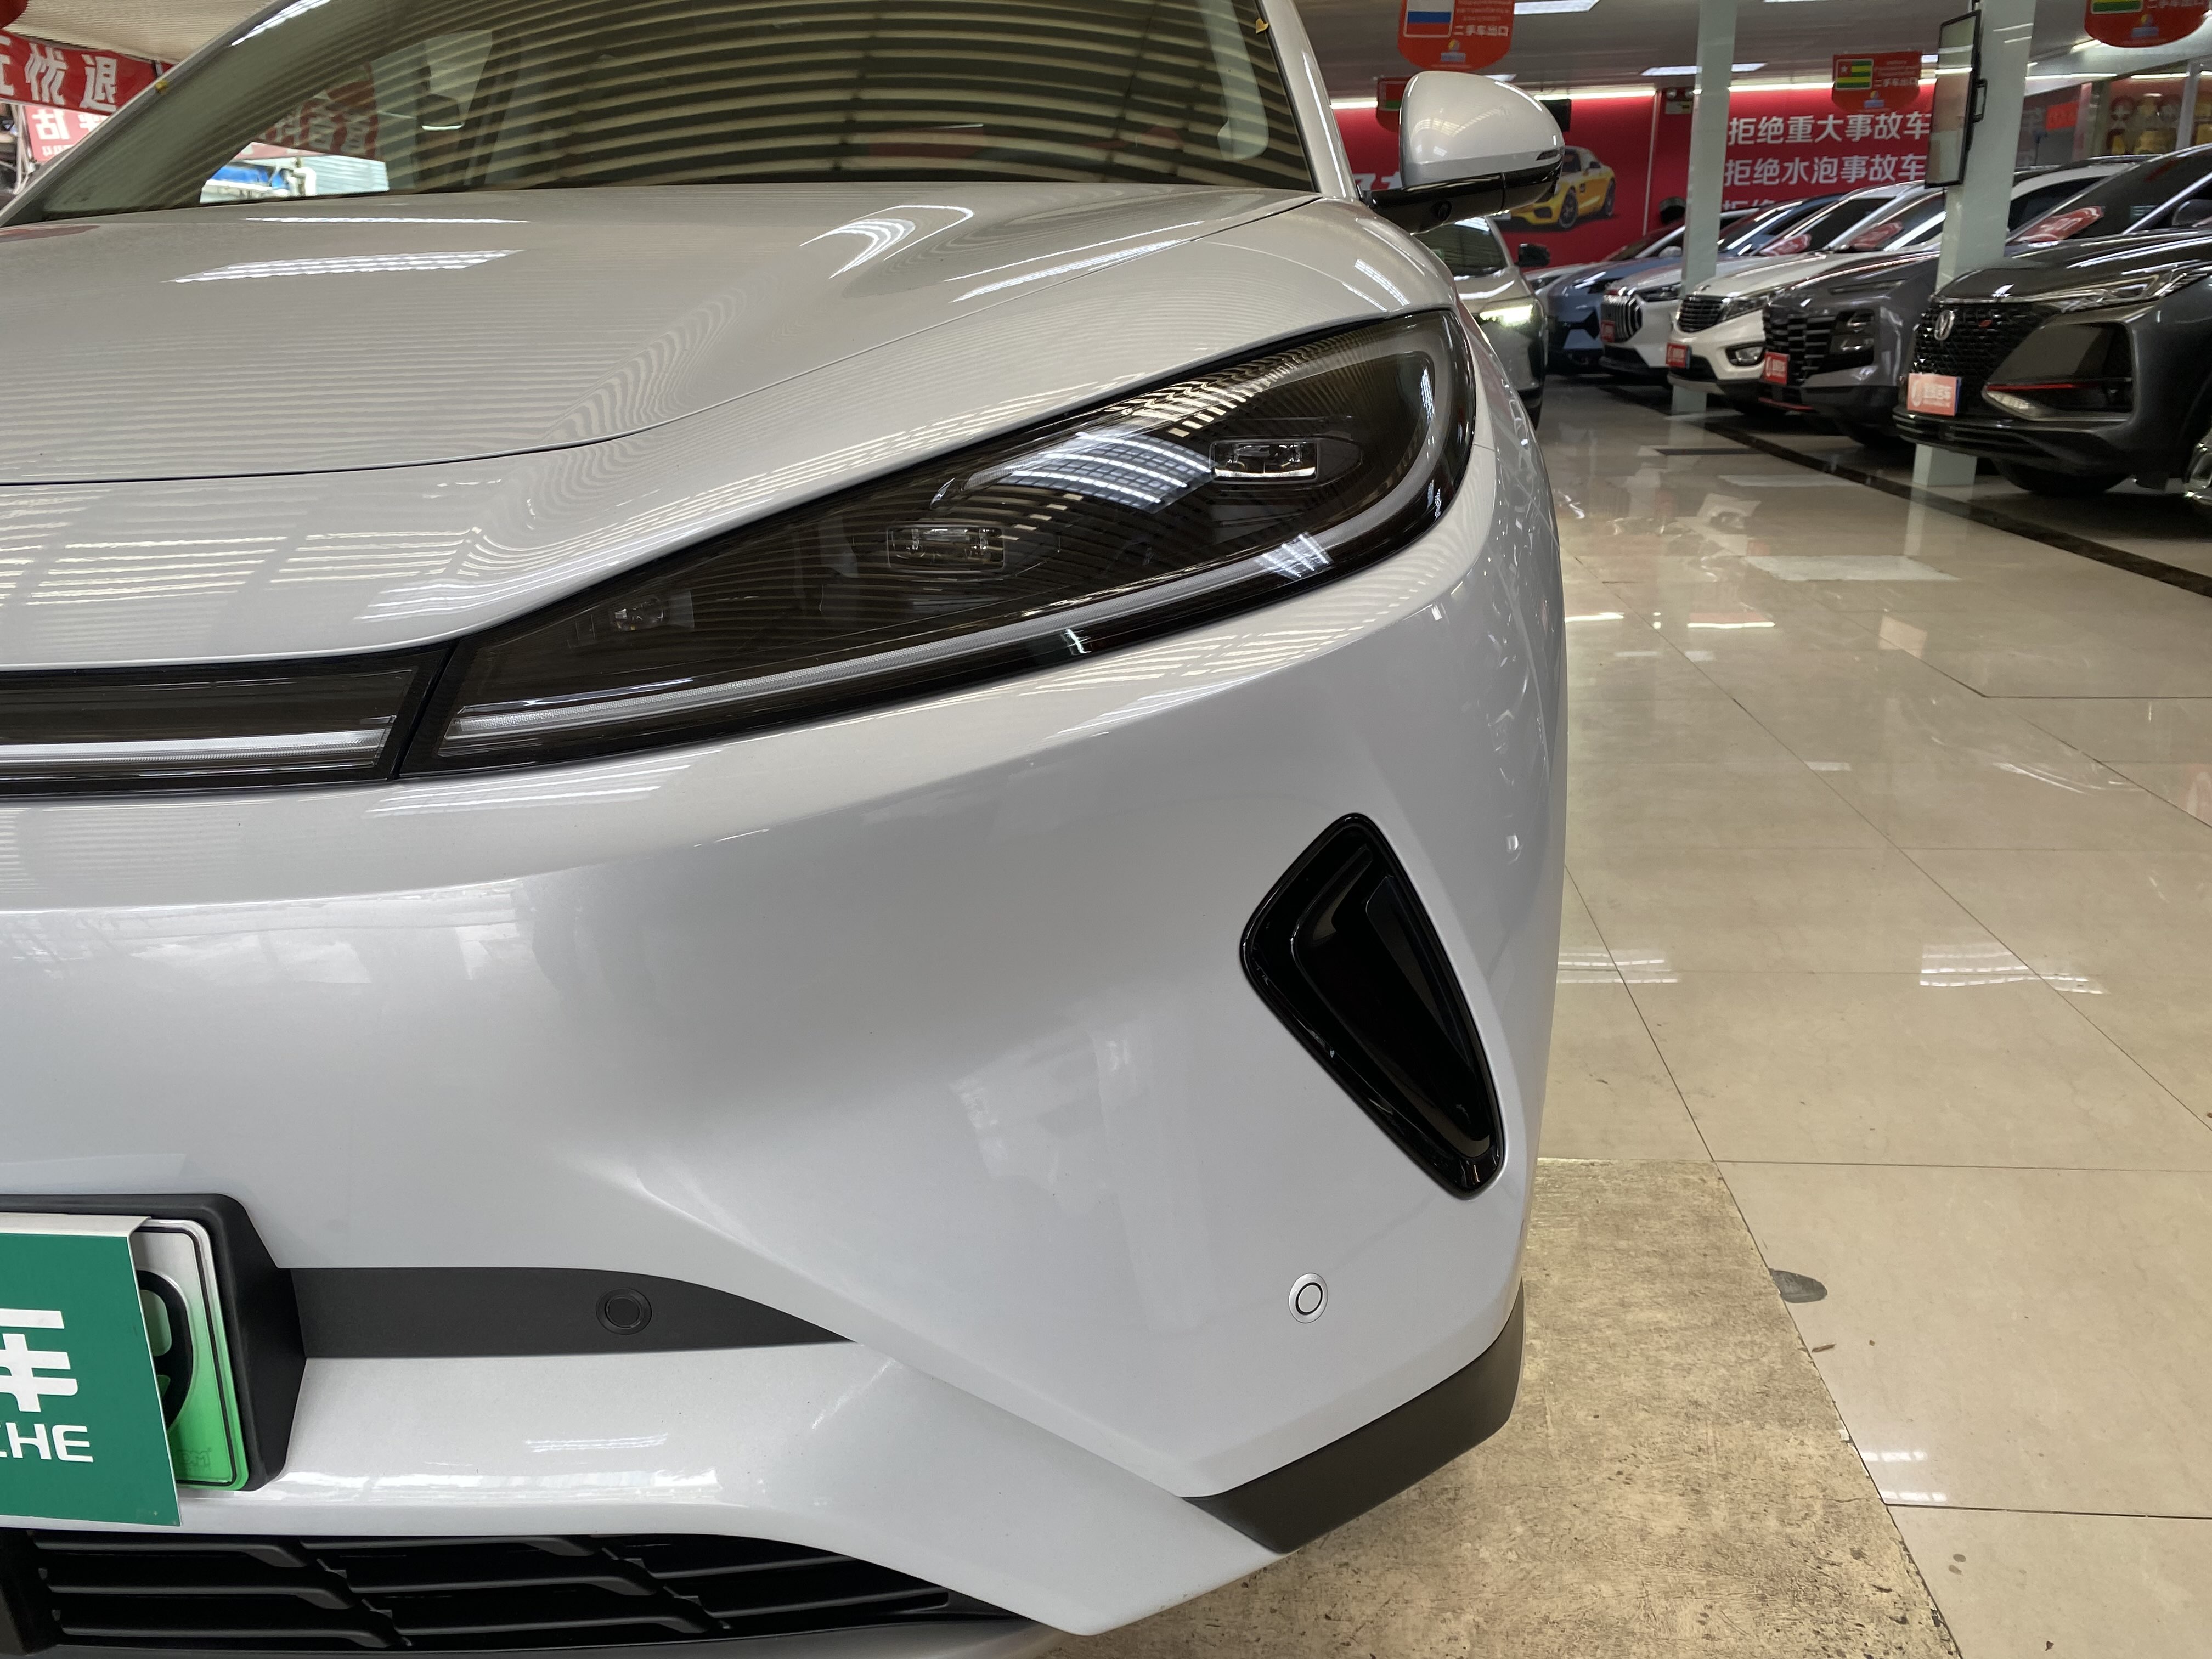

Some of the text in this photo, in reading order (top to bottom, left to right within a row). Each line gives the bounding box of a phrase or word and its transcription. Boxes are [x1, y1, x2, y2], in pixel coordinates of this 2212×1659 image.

[1729, 111, 1932, 146] 拒绝重大事故车
[1724, 154, 1928, 187] 拒绝水泡事故车
[0, 1422, 94, 1463] HE
